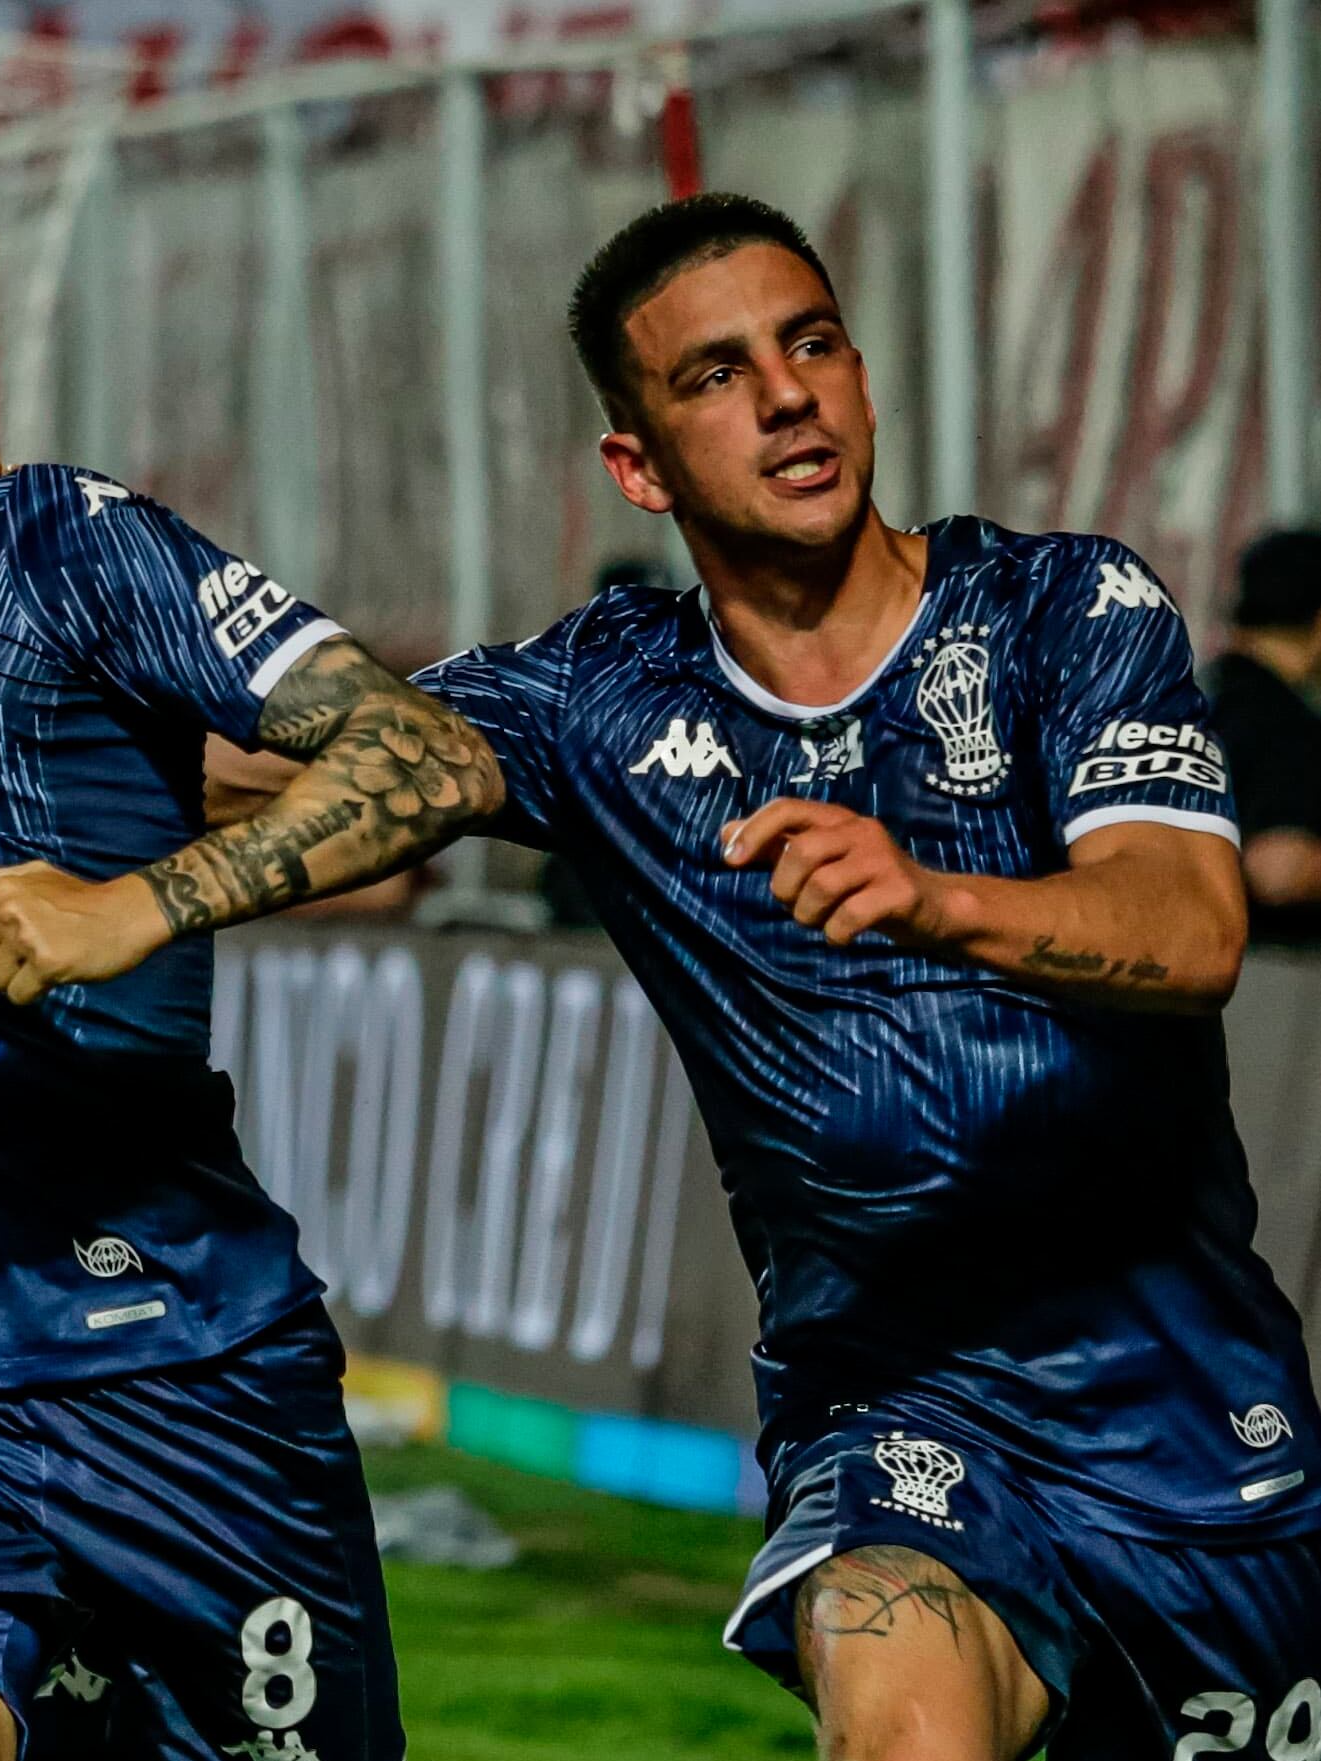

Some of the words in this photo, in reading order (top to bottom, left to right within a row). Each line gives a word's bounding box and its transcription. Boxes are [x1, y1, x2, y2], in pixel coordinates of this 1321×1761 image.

[1082, 719, 1223, 766] lecha
[1076, 753, 1223, 789] BUS
[241, 1597, 317, 1729] 8
